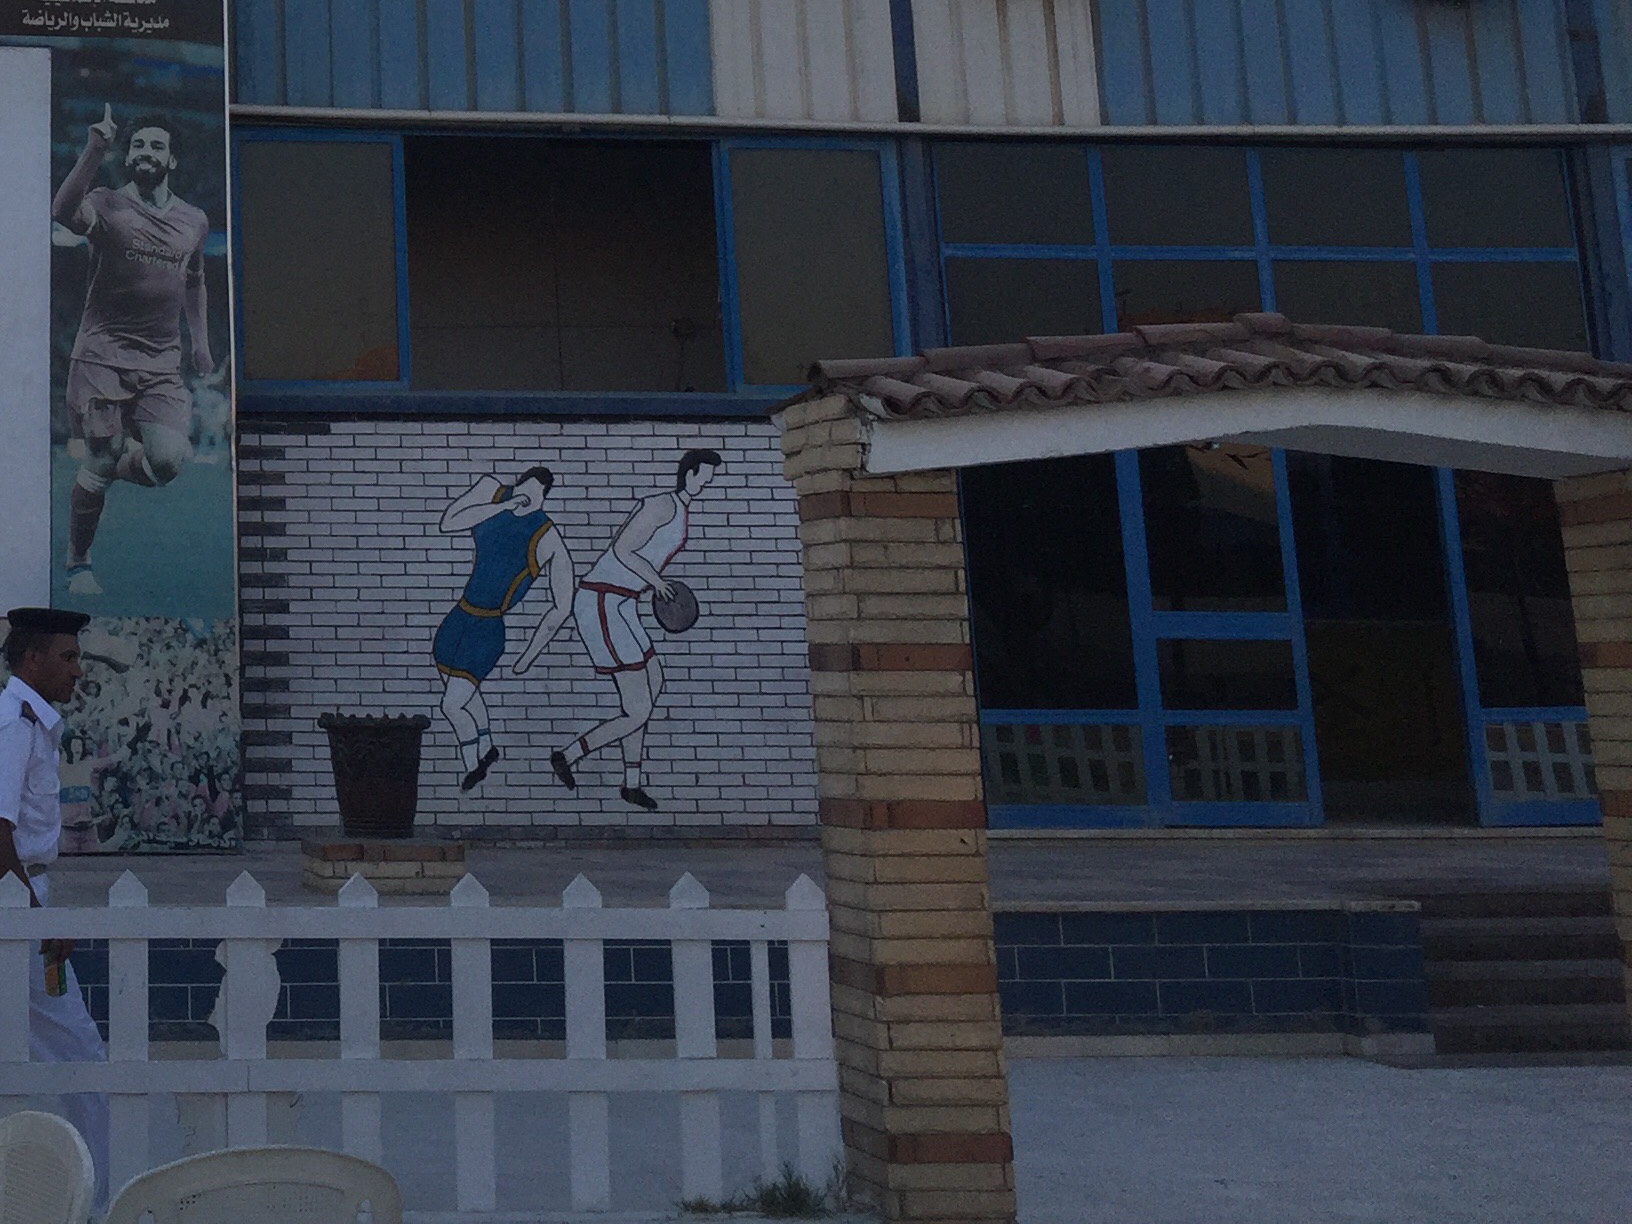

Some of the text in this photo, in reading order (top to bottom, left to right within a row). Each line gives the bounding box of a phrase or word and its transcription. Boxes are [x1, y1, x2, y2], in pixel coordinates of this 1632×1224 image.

[21, 9, 170, 34] مديرية الشباب والرياضة
[125, 249, 180, 271] Chartered
